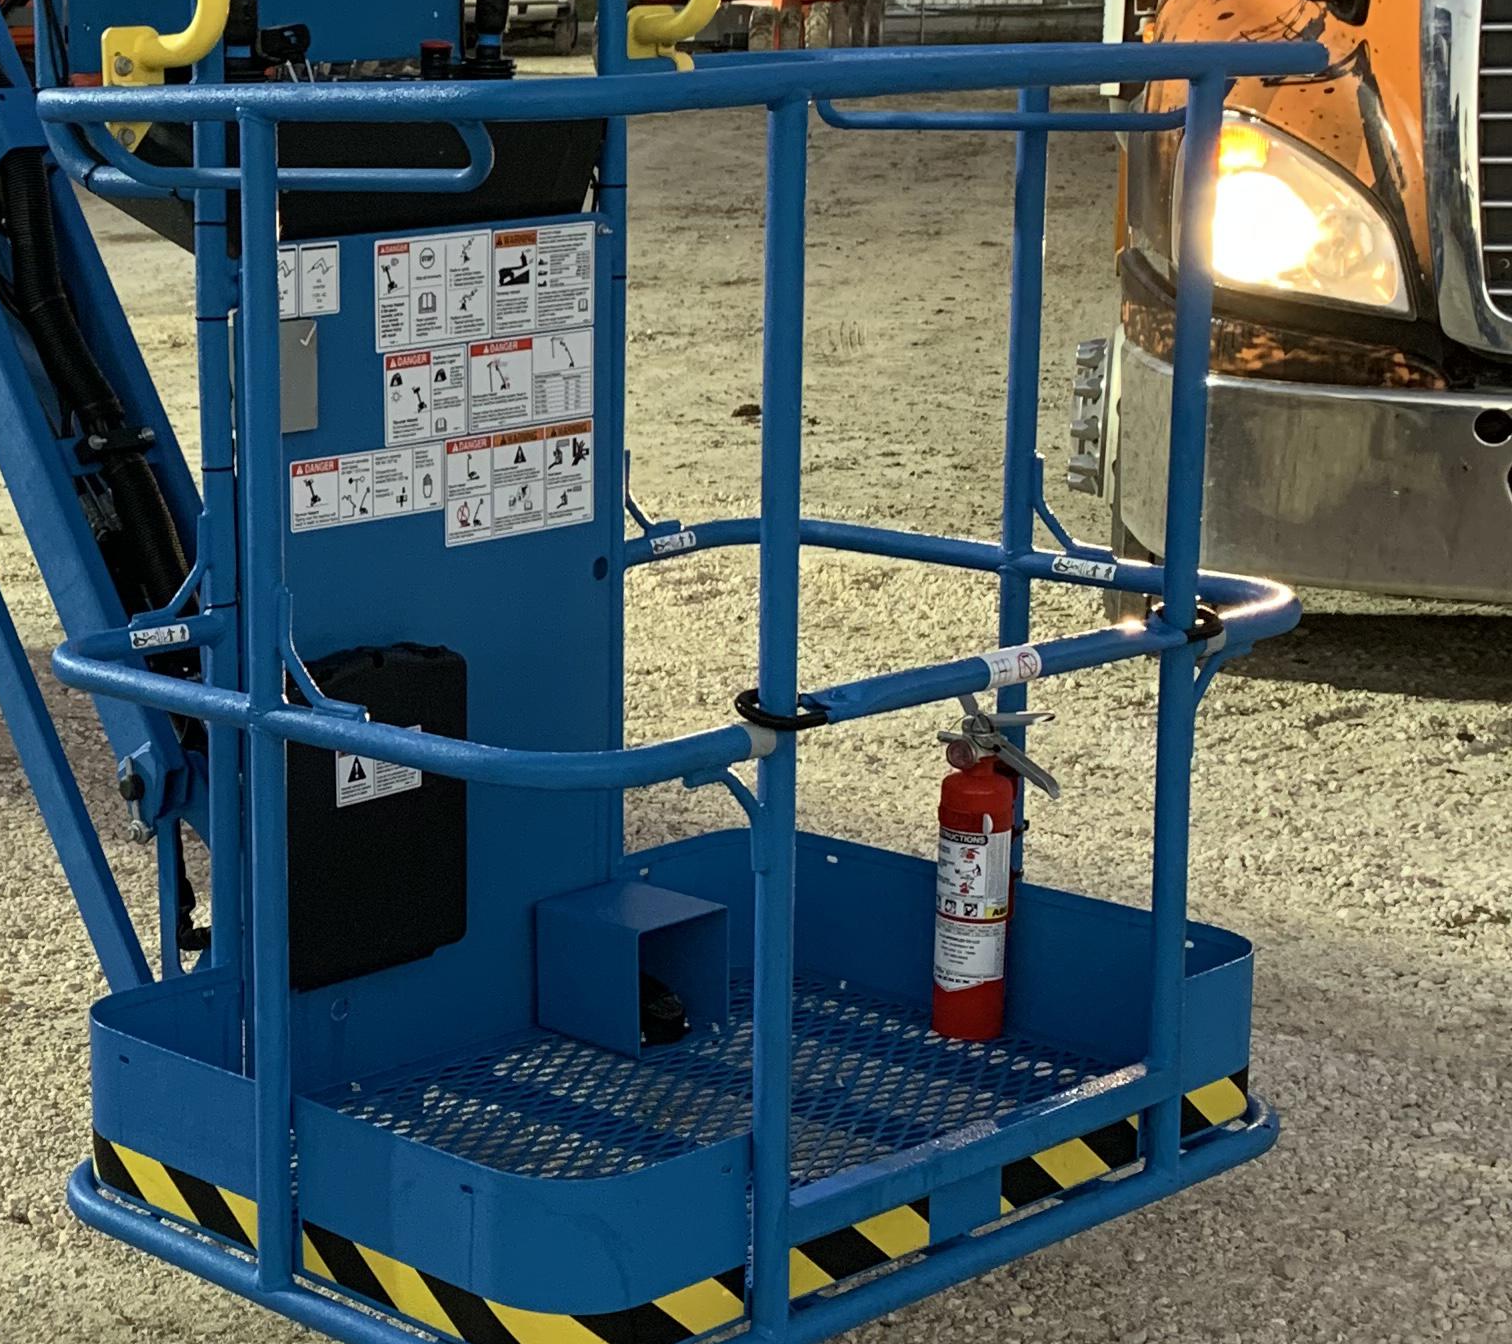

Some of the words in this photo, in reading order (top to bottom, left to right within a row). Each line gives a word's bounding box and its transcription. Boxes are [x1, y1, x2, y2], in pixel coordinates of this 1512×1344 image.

[489, 340, 519, 354] DANGER
[397, 353, 428, 367] DANGER
[458, 437, 487, 452] DANGER
[304, 460, 335, 474] DANGER
